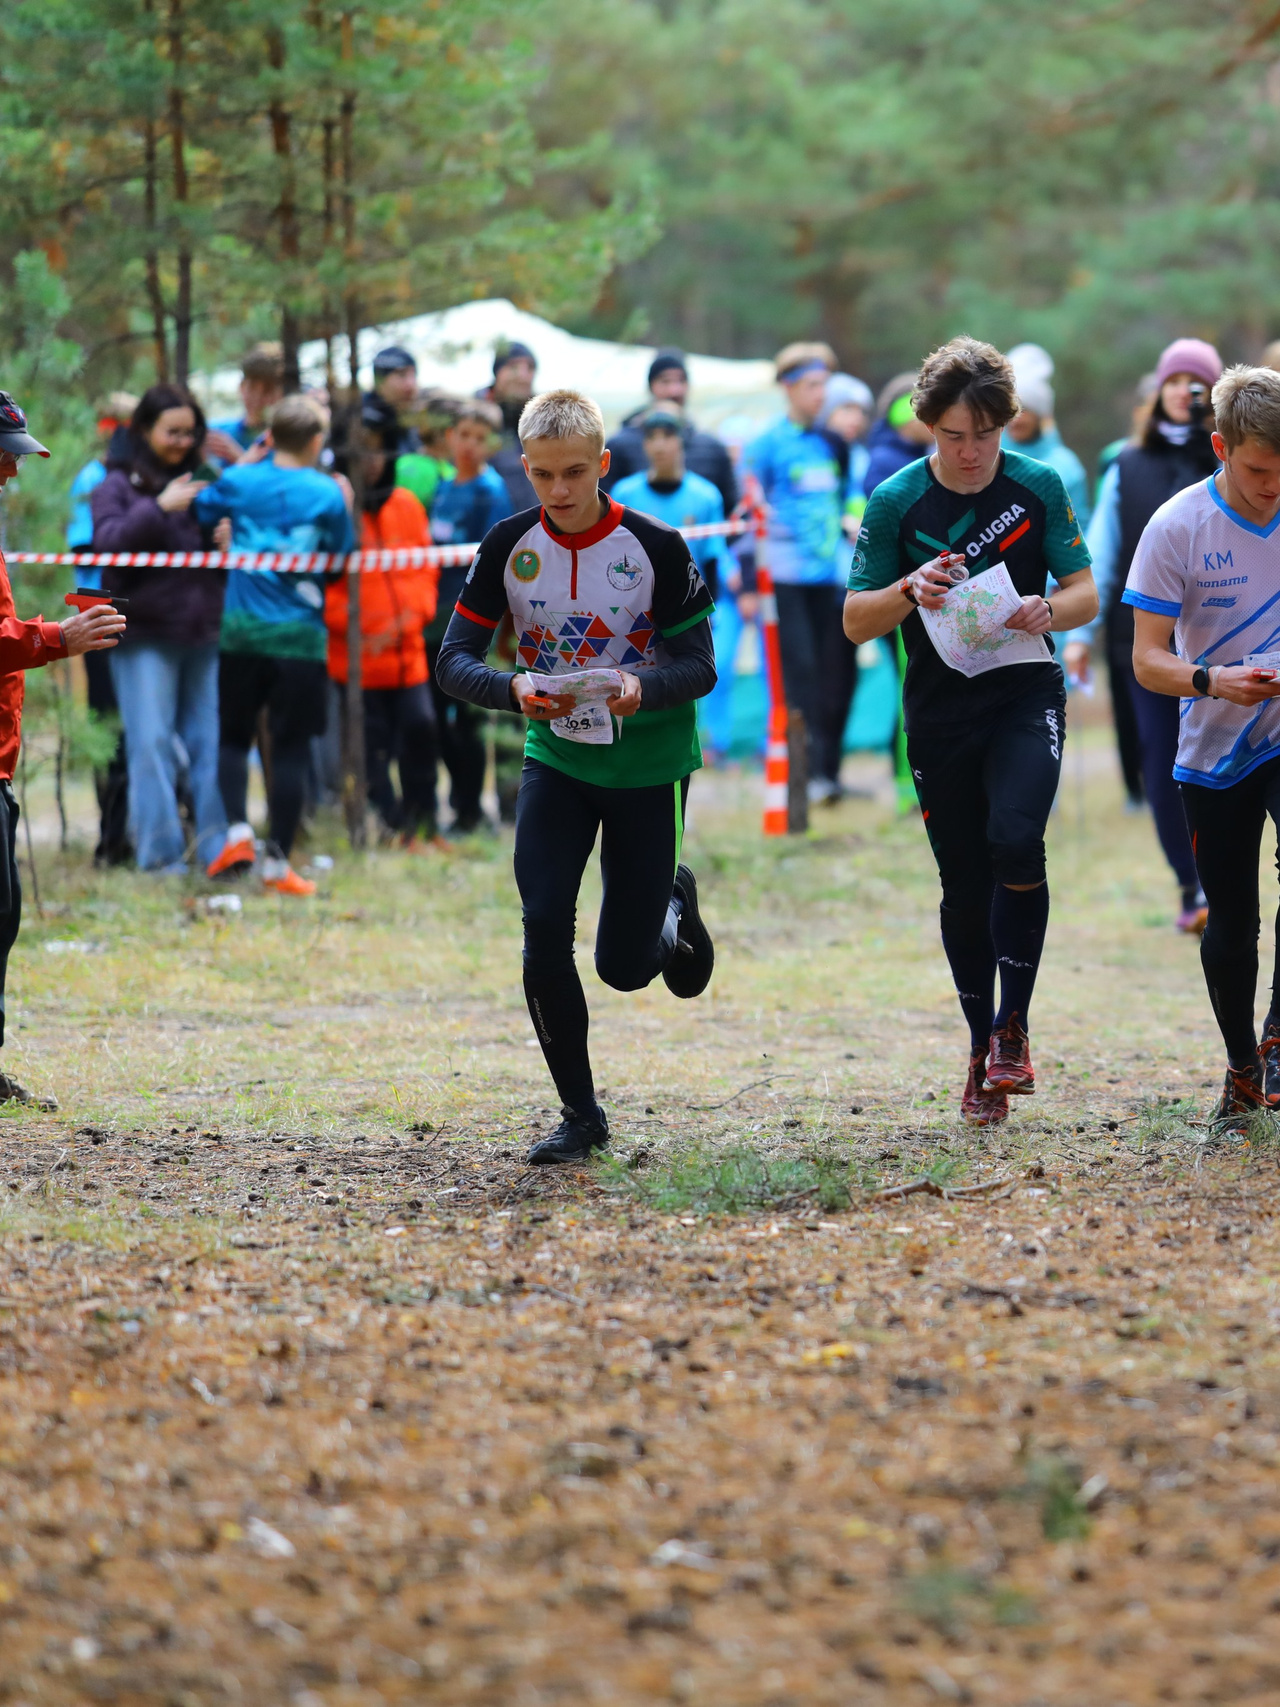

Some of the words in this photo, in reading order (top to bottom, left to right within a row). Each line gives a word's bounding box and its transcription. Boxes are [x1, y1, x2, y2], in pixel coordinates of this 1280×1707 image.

[966, 503, 1026, 557] O-UGRA
[1203, 549, 1234, 571] KM
[1196, 575, 1249, 588] noname
